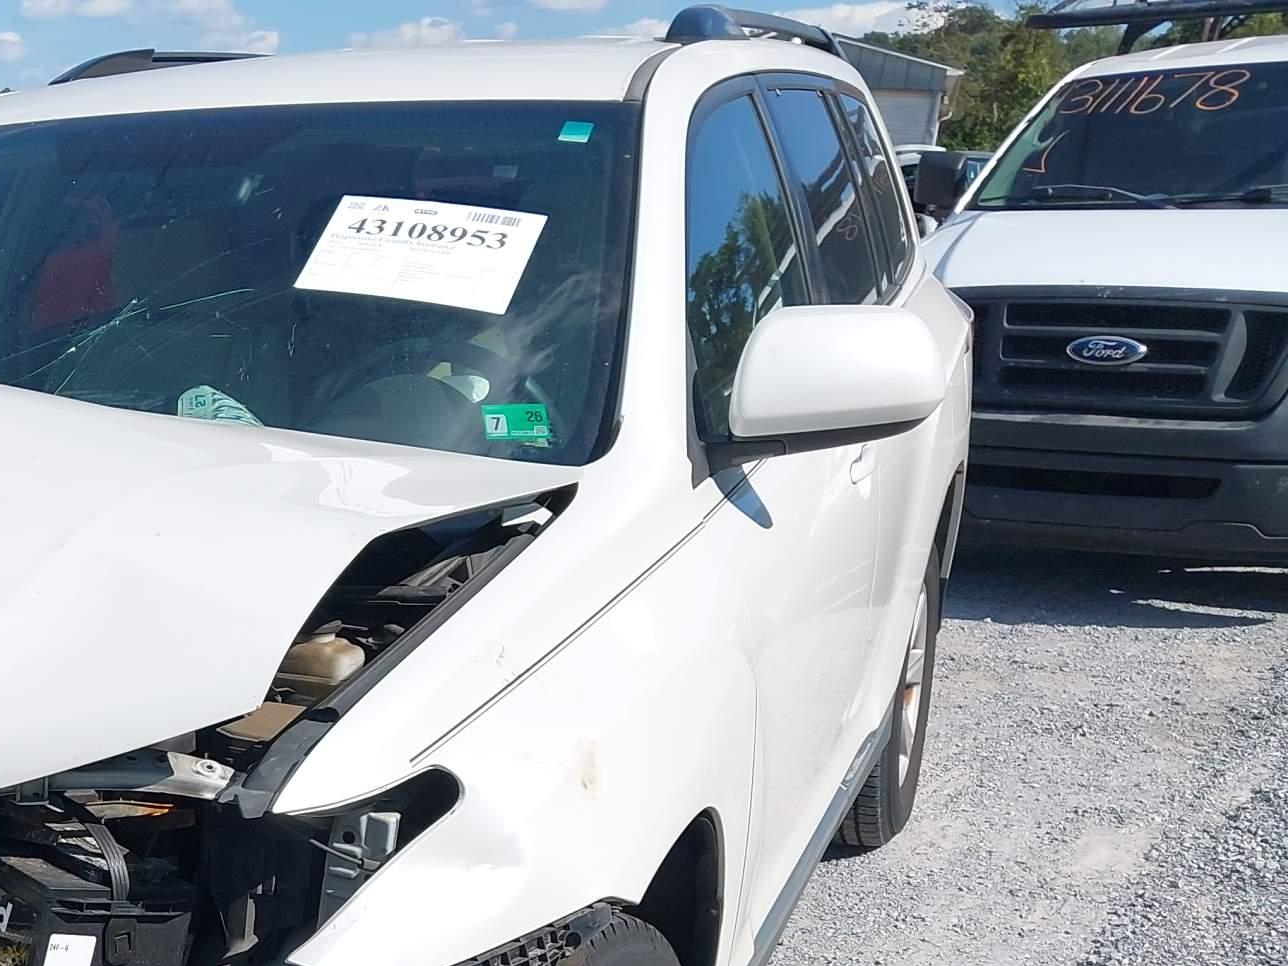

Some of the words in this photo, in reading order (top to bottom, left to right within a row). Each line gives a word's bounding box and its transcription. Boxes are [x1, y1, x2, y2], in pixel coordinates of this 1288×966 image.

[347, 217, 509, 250] 43108953
[1082, 340, 1128, 359] Ford
[490, 416, 501, 432] 7
[525, 410, 543, 423] 26
